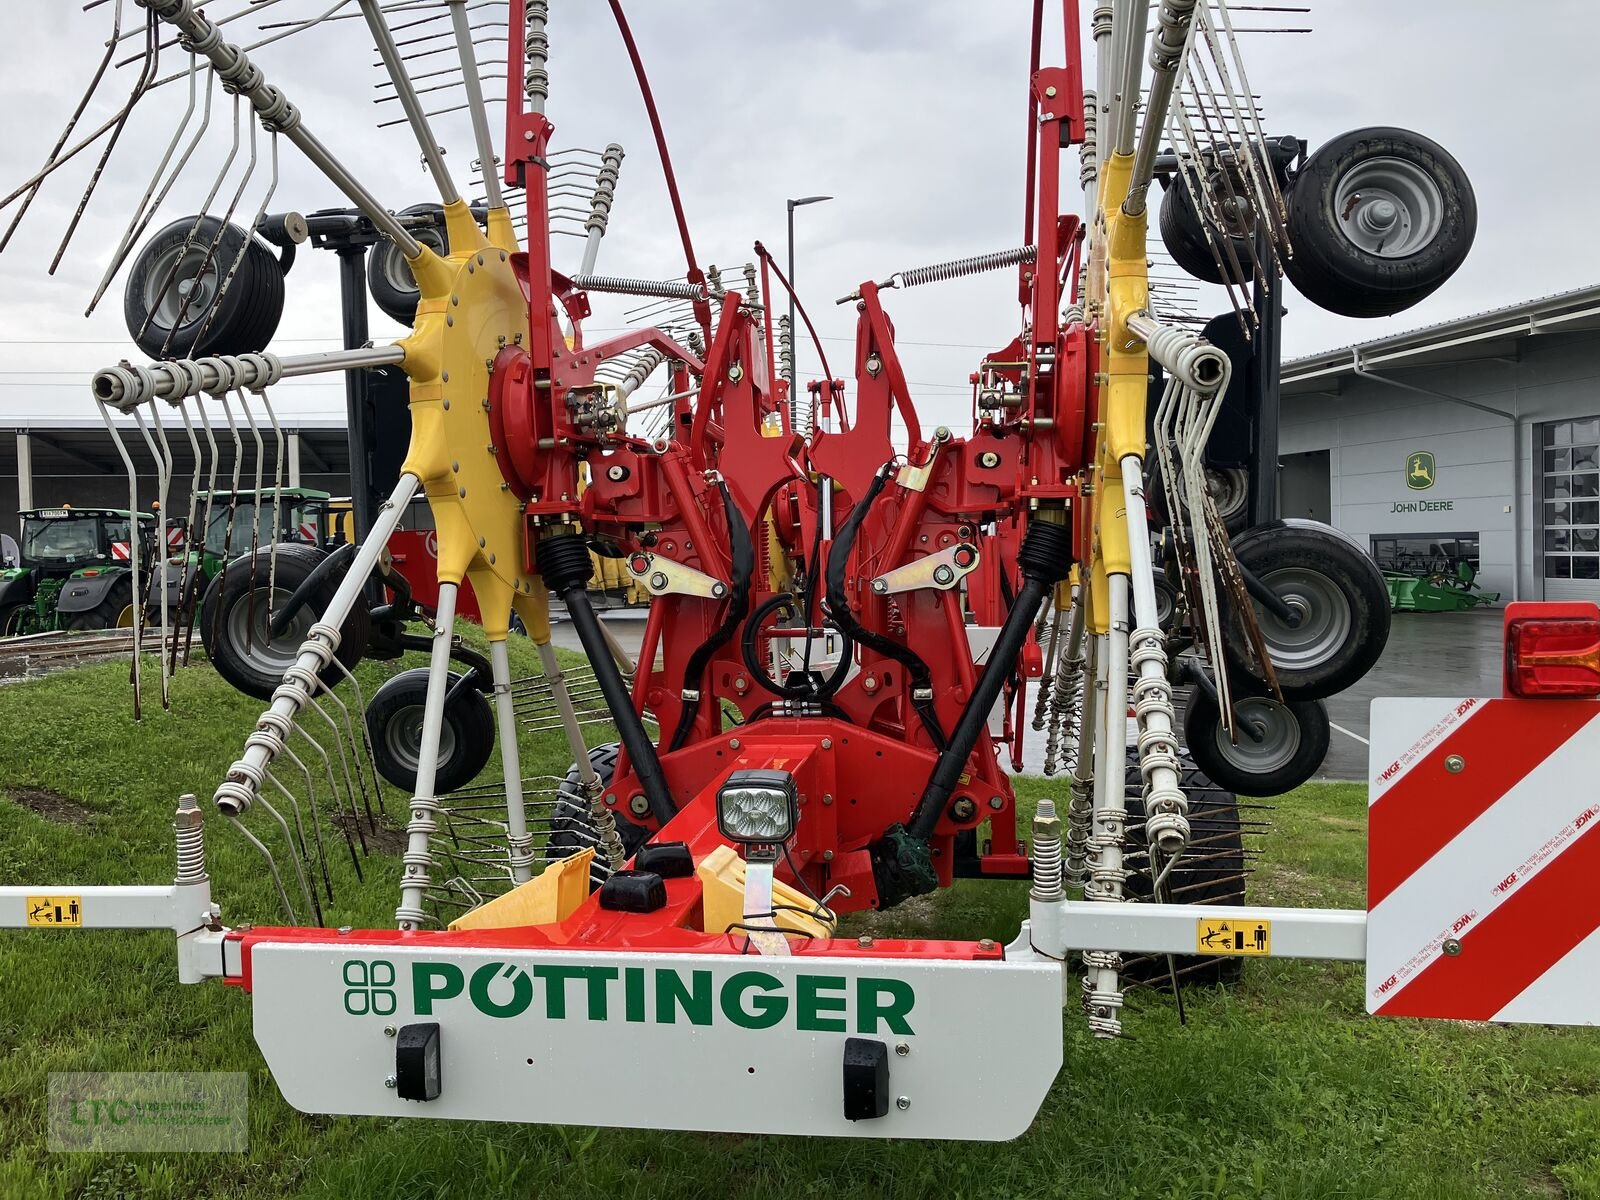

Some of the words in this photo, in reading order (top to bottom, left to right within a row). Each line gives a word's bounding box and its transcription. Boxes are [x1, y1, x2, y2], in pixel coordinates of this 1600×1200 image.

[1454, 697, 1477, 717] WGF
[1381, 761, 1402, 780] WGF
[1573, 809, 1595, 830] WGF
[1497, 872, 1518, 892] WGF
[1451, 914, 1472, 934] WGF
[1378, 974, 1399, 994] WGF
[411, 962, 916, 1036] PÖTTINGER
